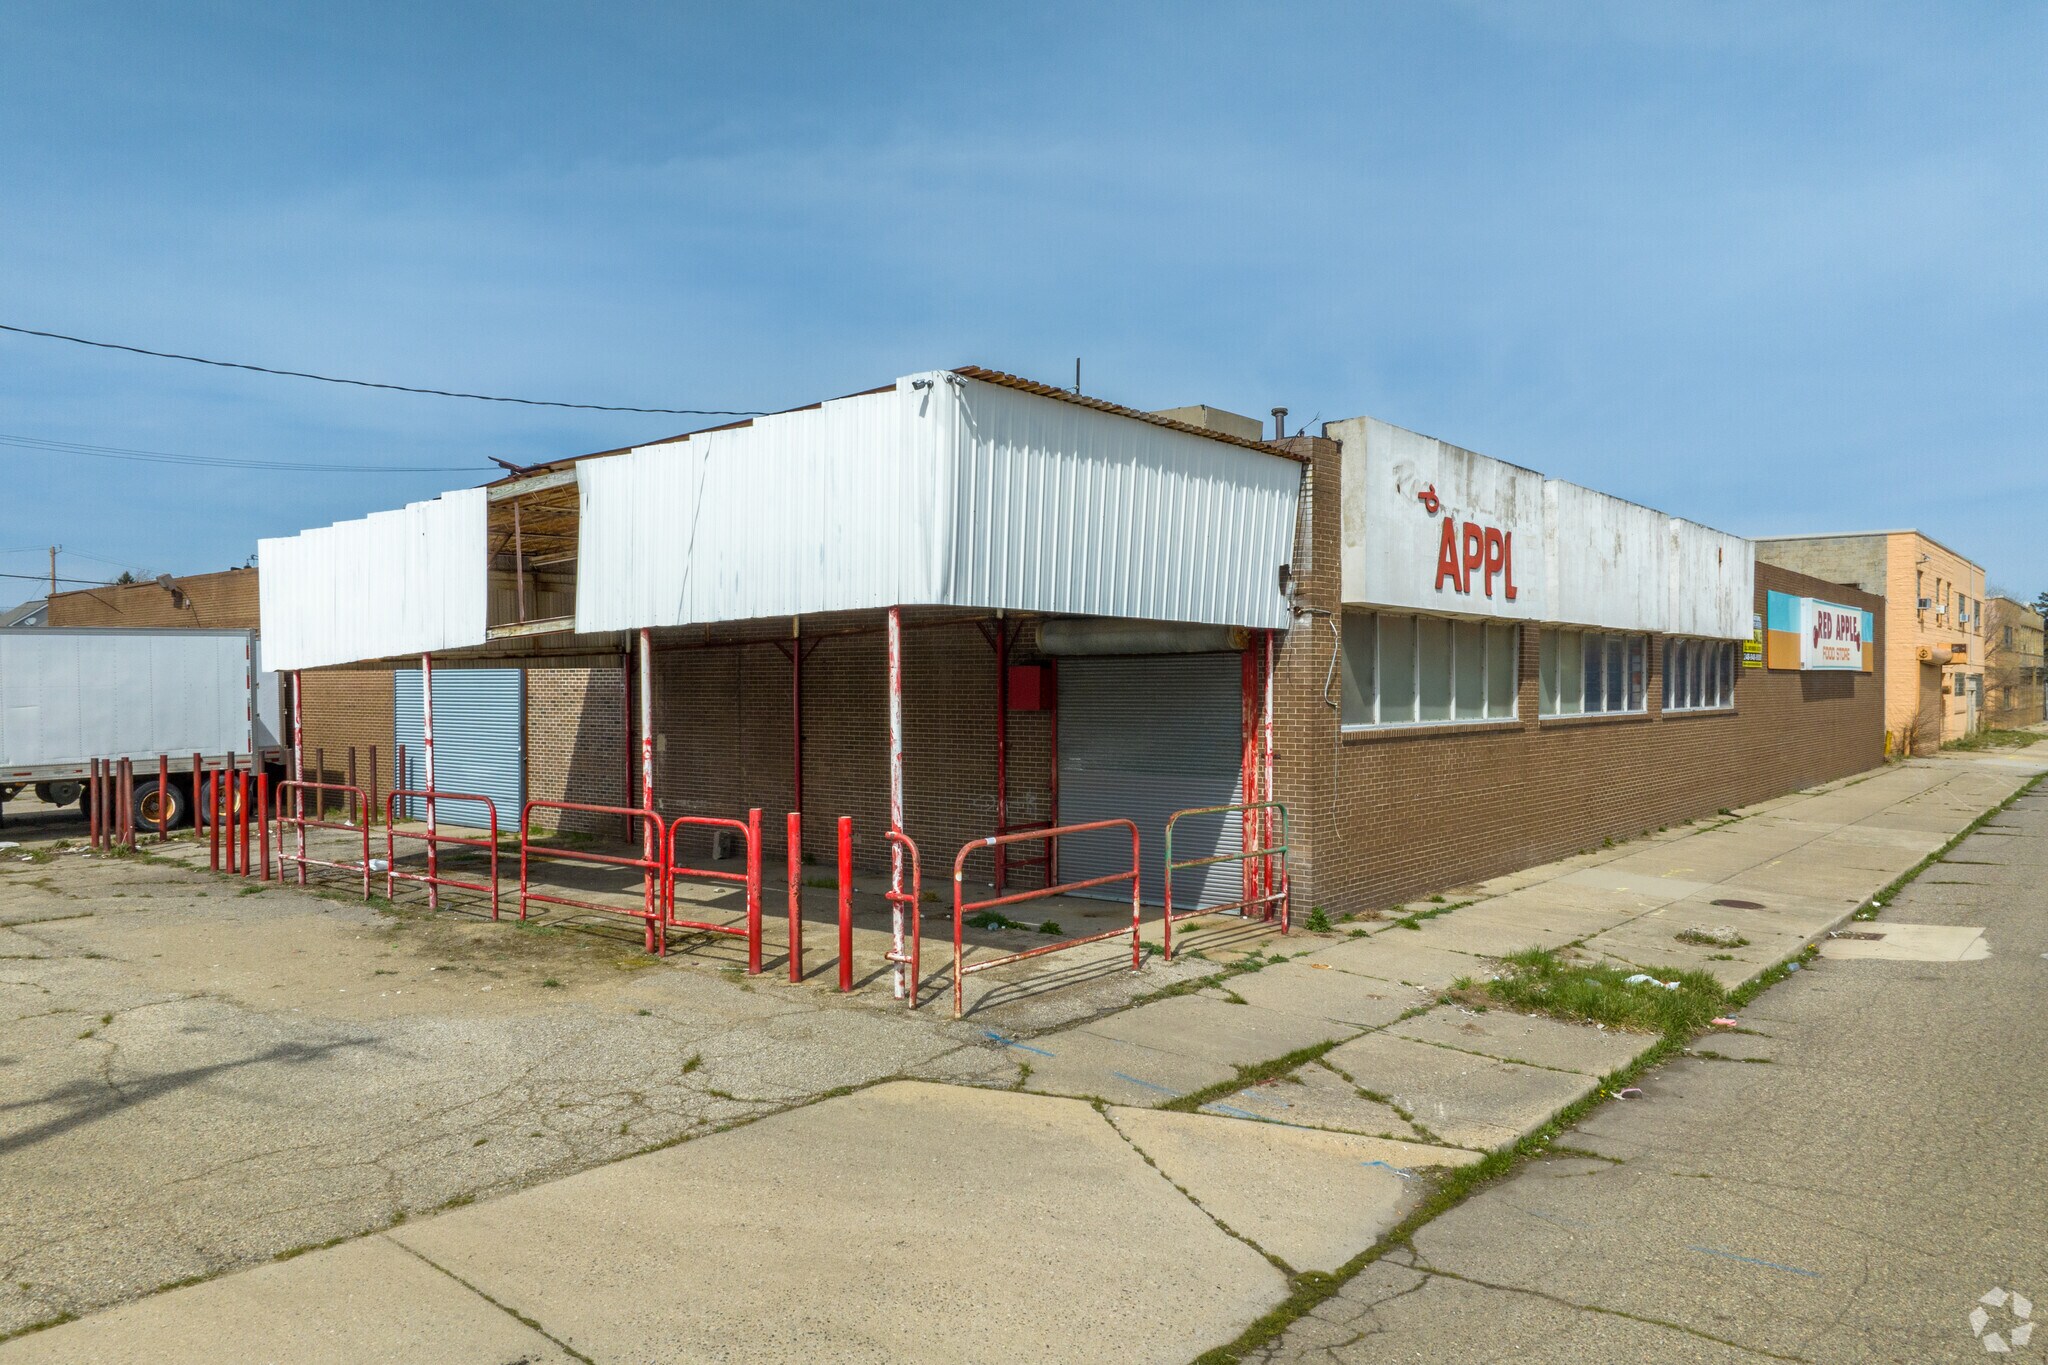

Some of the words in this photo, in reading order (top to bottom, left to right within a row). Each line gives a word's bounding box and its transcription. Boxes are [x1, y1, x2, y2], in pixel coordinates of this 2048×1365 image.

[1435, 516, 1518, 599] APPL
[1818, 610, 1832, 639] RED
[1836, 614, 1857, 642] APPLE
[1823, 646, 1835, 660] FOOD
[1836, 647, 1850, 661] STORE
